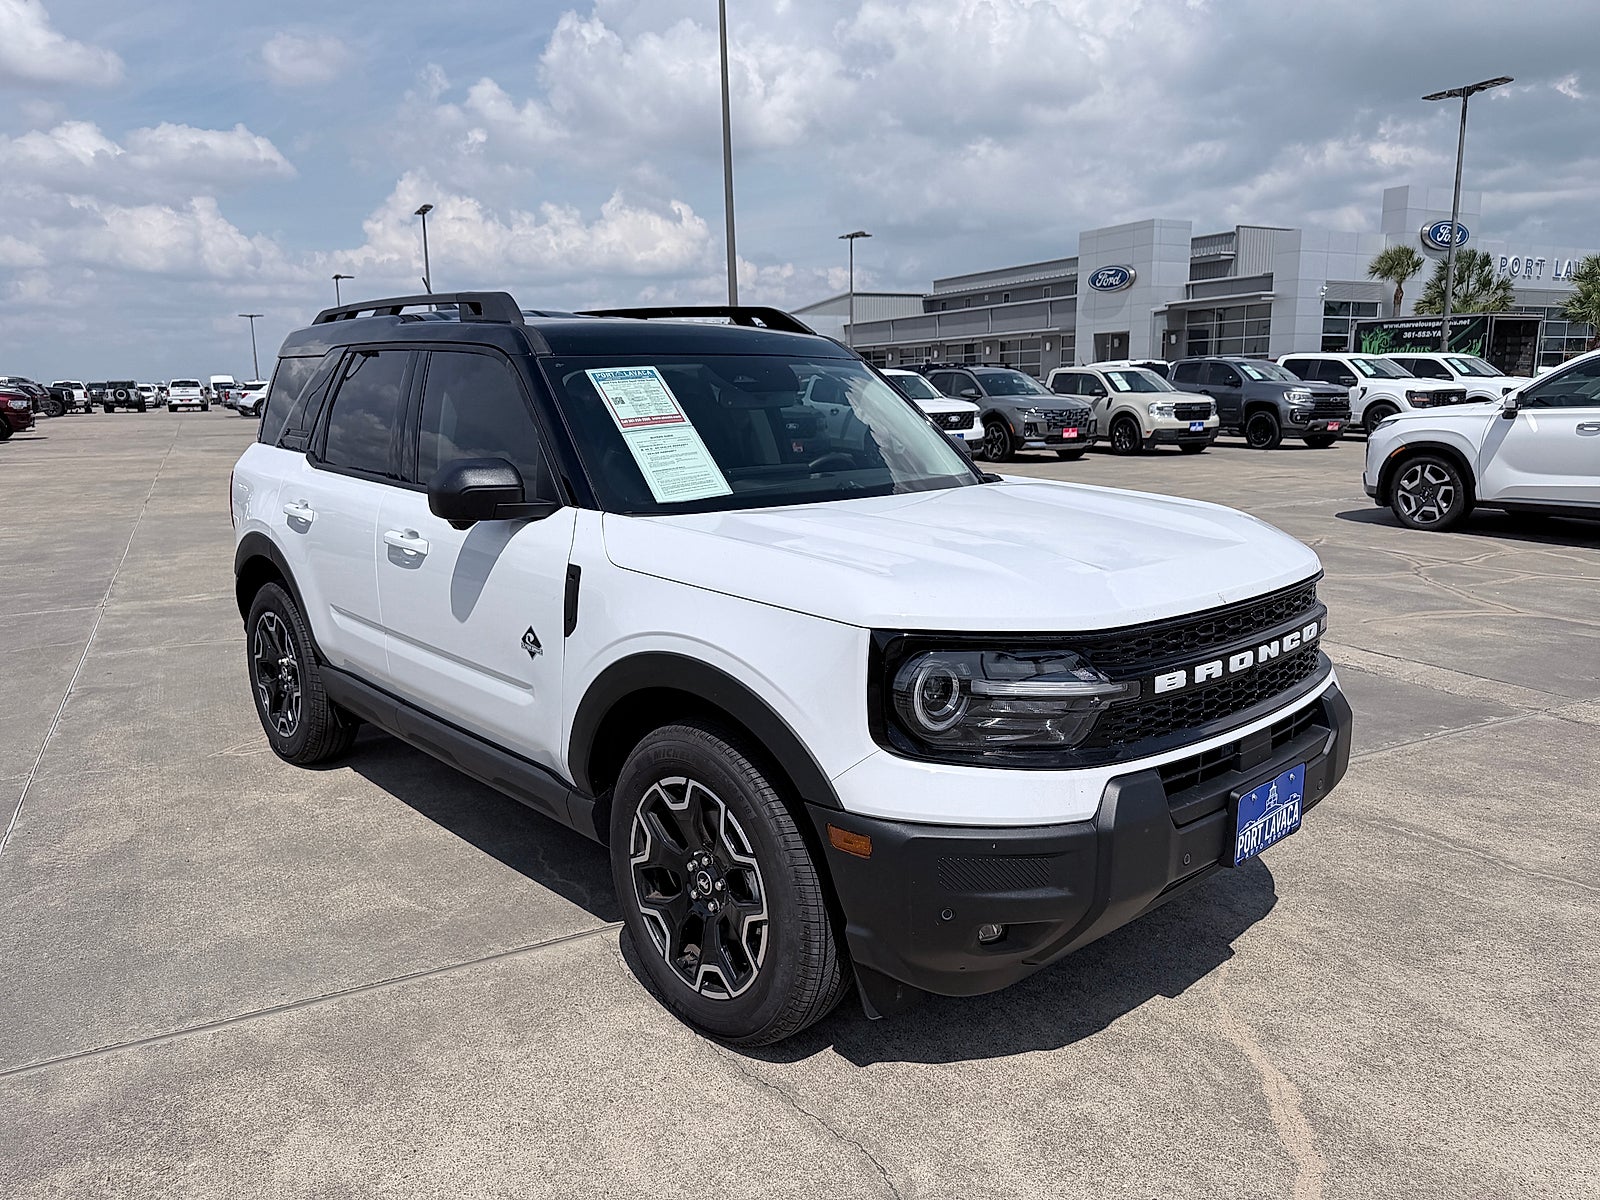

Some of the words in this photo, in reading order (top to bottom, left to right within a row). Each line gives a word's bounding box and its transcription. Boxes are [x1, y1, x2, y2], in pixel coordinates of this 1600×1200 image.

[1436, 225, 1463, 243] Fod
[1499, 256, 1546, 276] PORT
[1095, 269, 1122, 287] Ford
[1402, 329, 1452, 339] 361-552-YAD
[1154, 621, 1318, 694] BRONCO
[1237, 823, 1264, 858] PORT
[1264, 801, 1299, 841] LAVACA
[1245, 842, 1264, 859] AUTO
